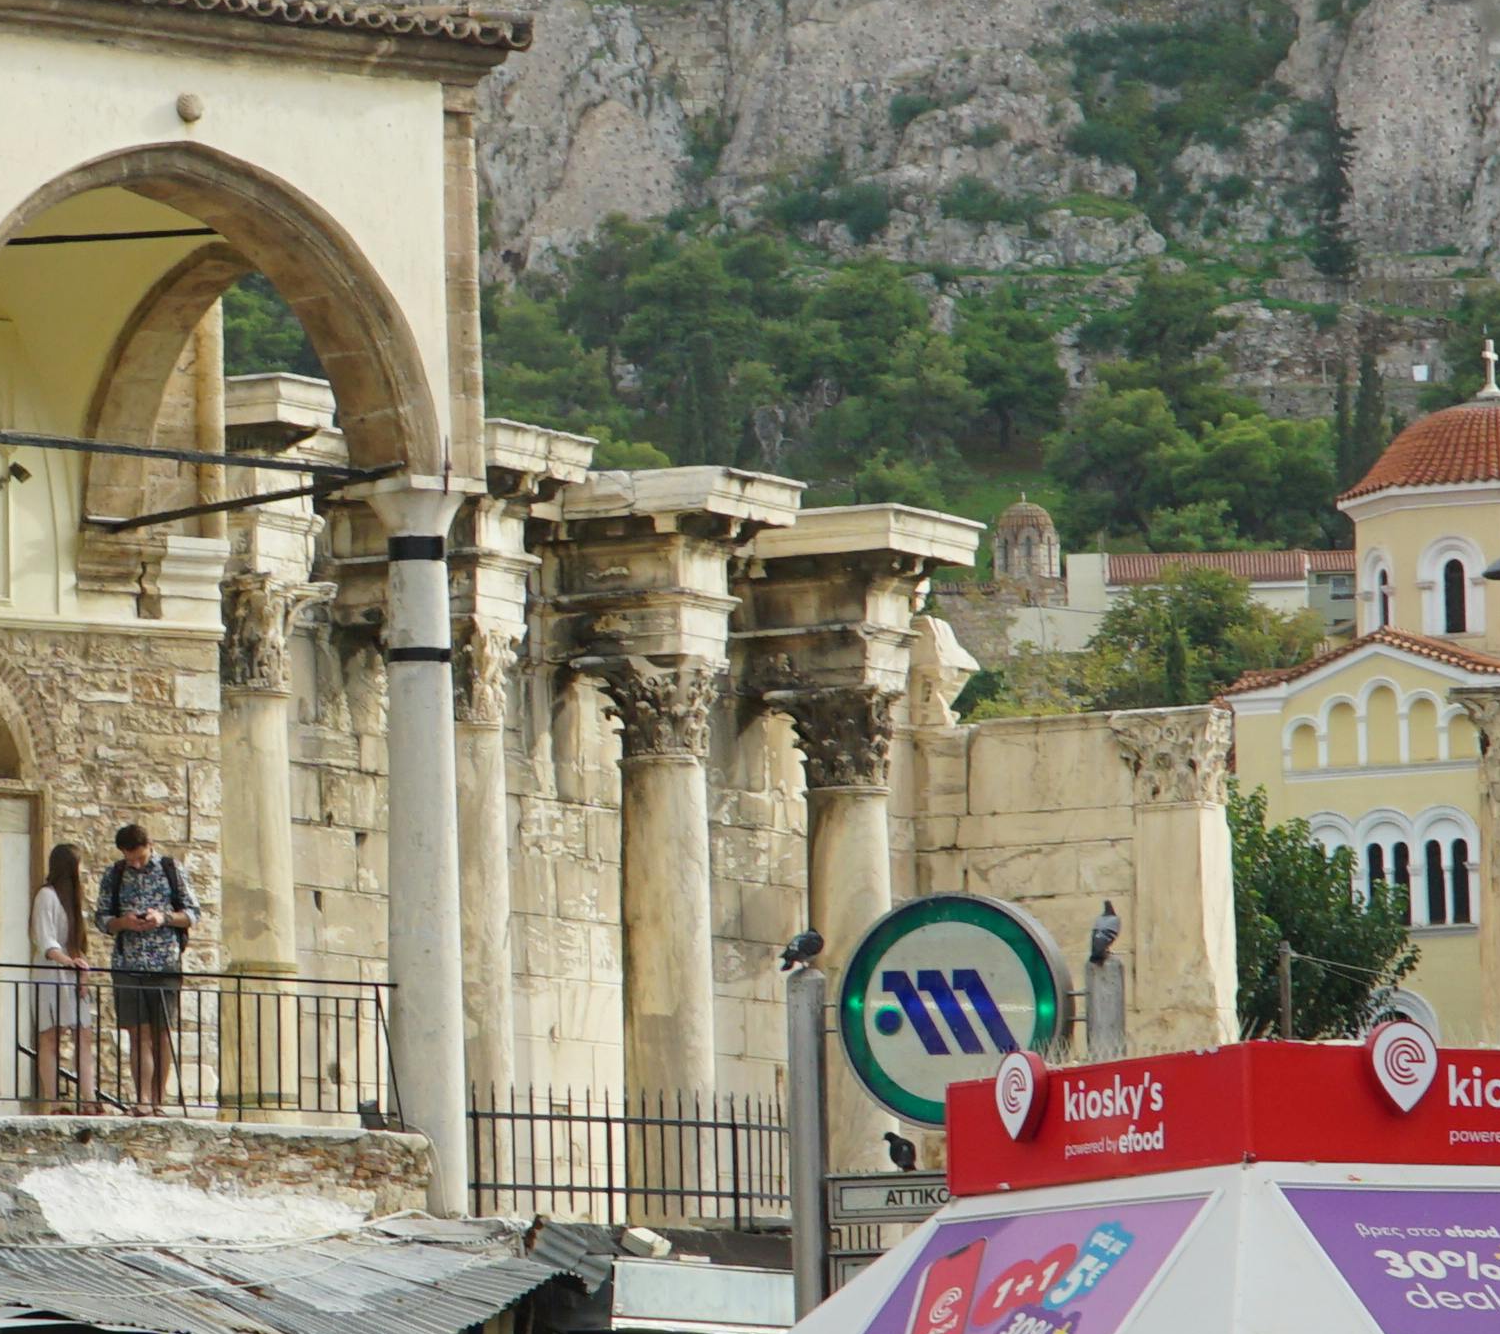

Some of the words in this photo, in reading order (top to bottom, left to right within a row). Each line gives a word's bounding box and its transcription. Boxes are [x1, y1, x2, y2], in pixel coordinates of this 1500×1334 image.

[1064, 1072, 1163, 1121] kiosky's
[1064, 1135, 1104, 1158] powered
[1105, 1136, 1118, 1156] by
[1118, 1122, 1164, 1153] efood
[1445, 1225, 1500, 1238] efood
